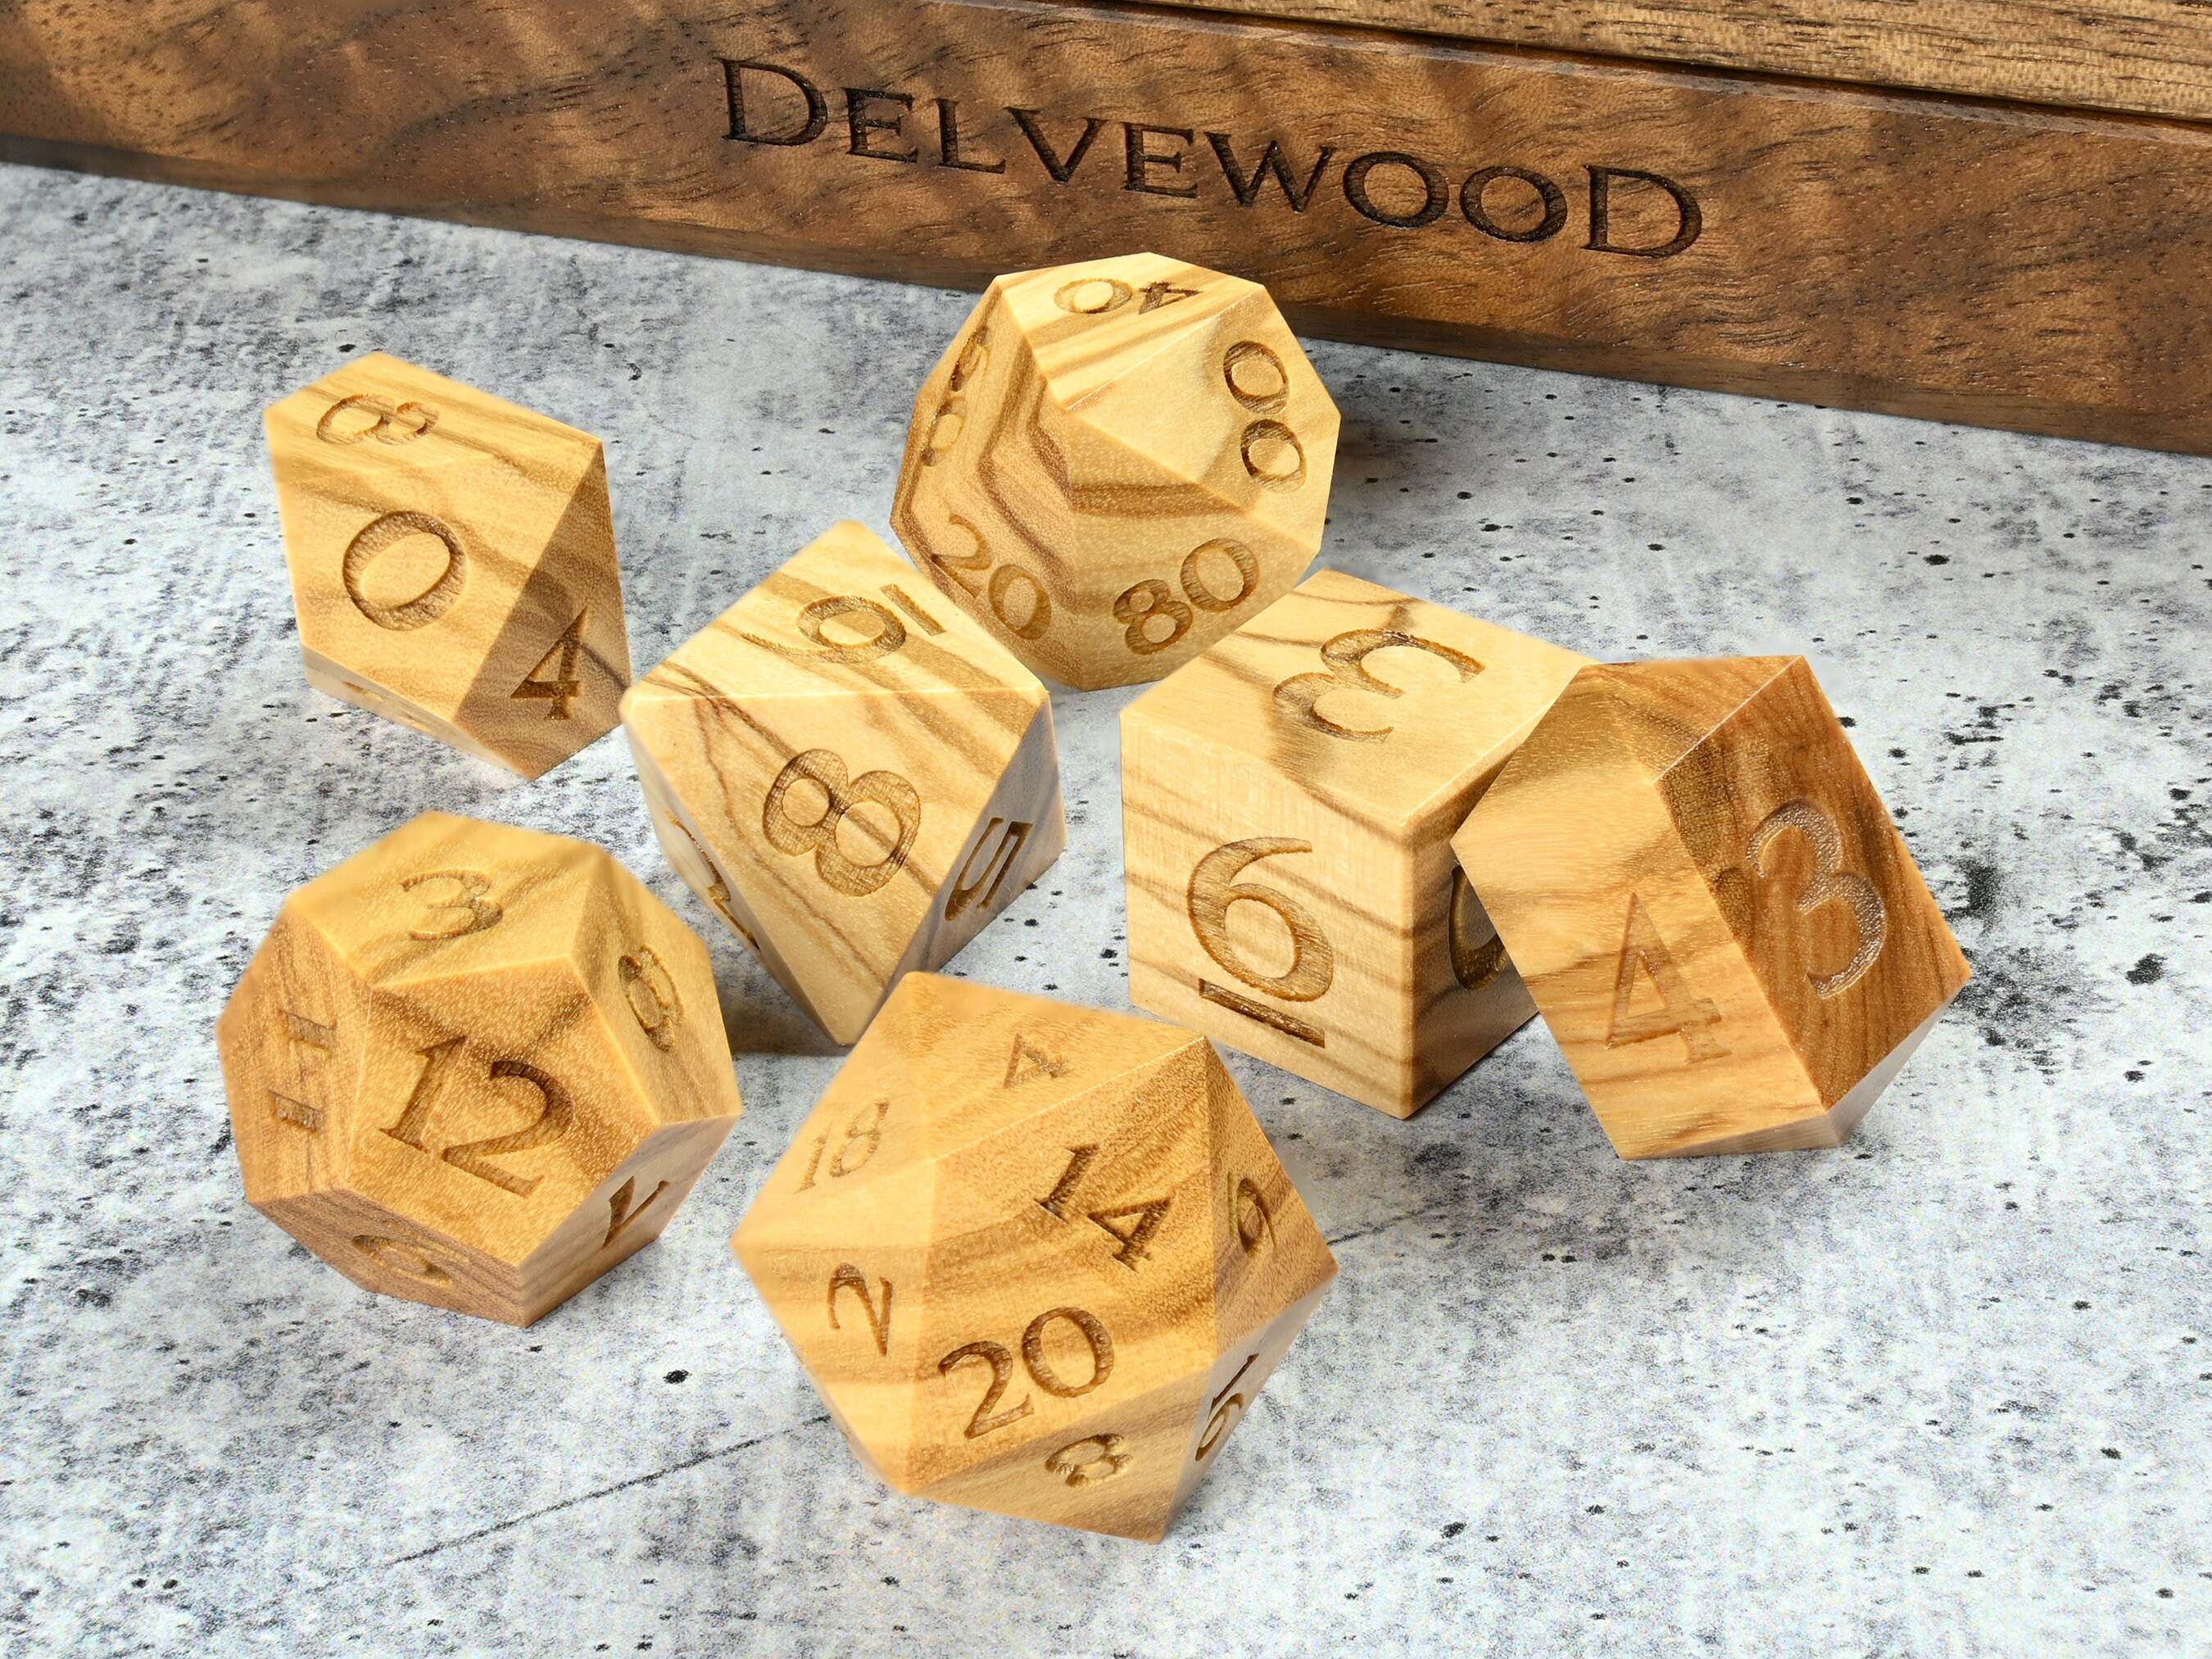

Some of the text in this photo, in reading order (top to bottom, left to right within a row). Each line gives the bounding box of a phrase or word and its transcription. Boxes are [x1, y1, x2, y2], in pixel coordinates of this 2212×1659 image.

[712, 55, 1703, 259] DELVEWOOD
[1054, 277, 1203, 315] 40
[316, 393, 439, 445] 8
[1223, 340, 1308, 492] 00
[342, 510, 468, 631] 0
[931, 513, 1052, 640] 20
[1113, 537, 1259, 655] 80
[511, 607, 579, 720] 4
[1272, 628, 1486, 743] 3
[763, 749, 921, 898] 8
[945, 817, 1033, 921] 5
[401, 868, 504, 940] 3
[1186, 836, 1334, 1049] 6
[1746, 800, 1887, 999] 3
[618, 944, 685, 1053] 8
[1604, 892, 1733, 1065] 4
[267, 1009, 337, 1135] 11
[379, 1035, 575, 1199] 12
[1004, 1033, 1068, 1090] 4
[795, 1098, 890, 1194] 18
[1034, 1144, 1172, 1272] 14
[827, 1262, 893, 1358] 2
[939, 1307, 1114, 1440] 20
[1195, 1353, 1259, 1462] 16
[1045, 1433, 1133, 1488] 8
